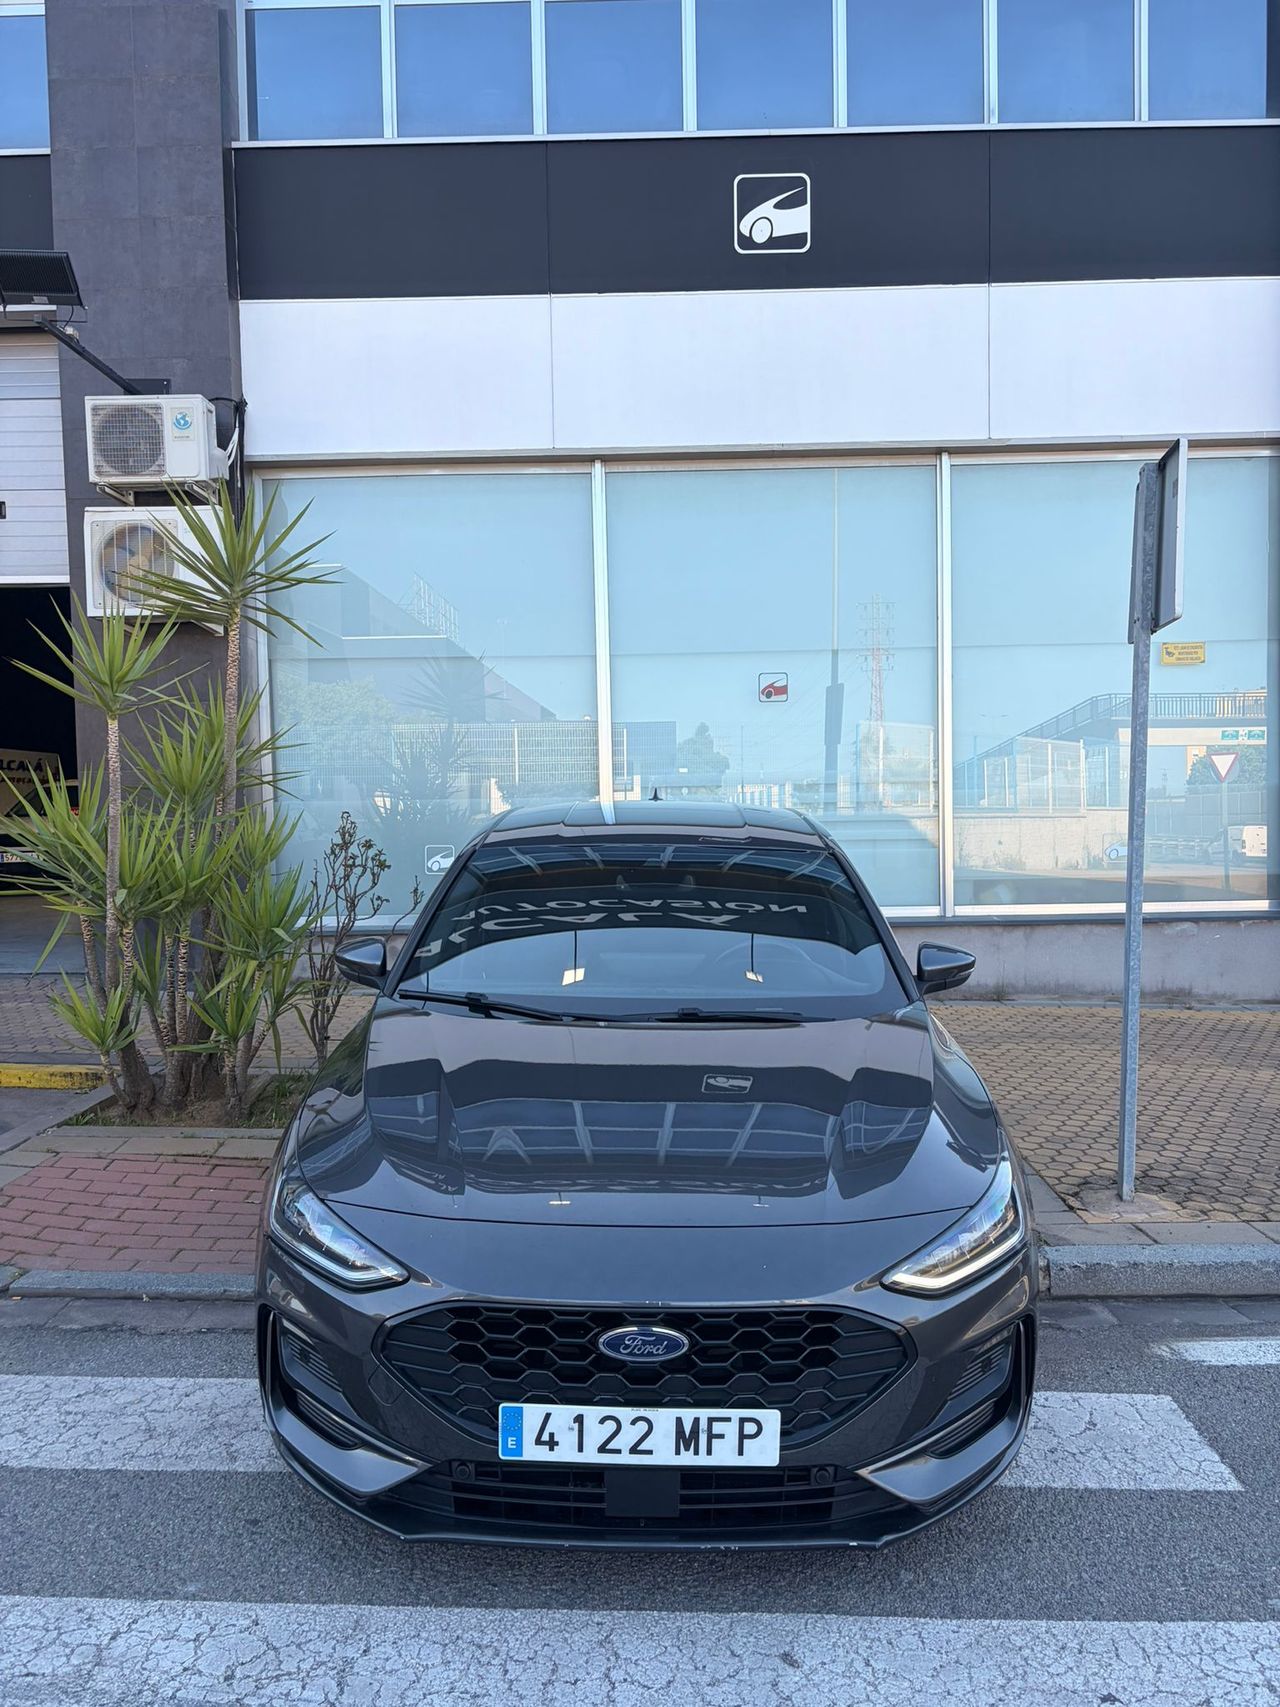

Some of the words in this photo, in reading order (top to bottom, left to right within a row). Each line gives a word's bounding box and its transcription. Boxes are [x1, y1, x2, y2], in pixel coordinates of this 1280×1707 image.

[619, 1334, 668, 1356] Ford
[507, 1437, 517, 1449] E
[534, 1412, 654, 1456] 4122
[674, 1416, 764, 1457] MFP
